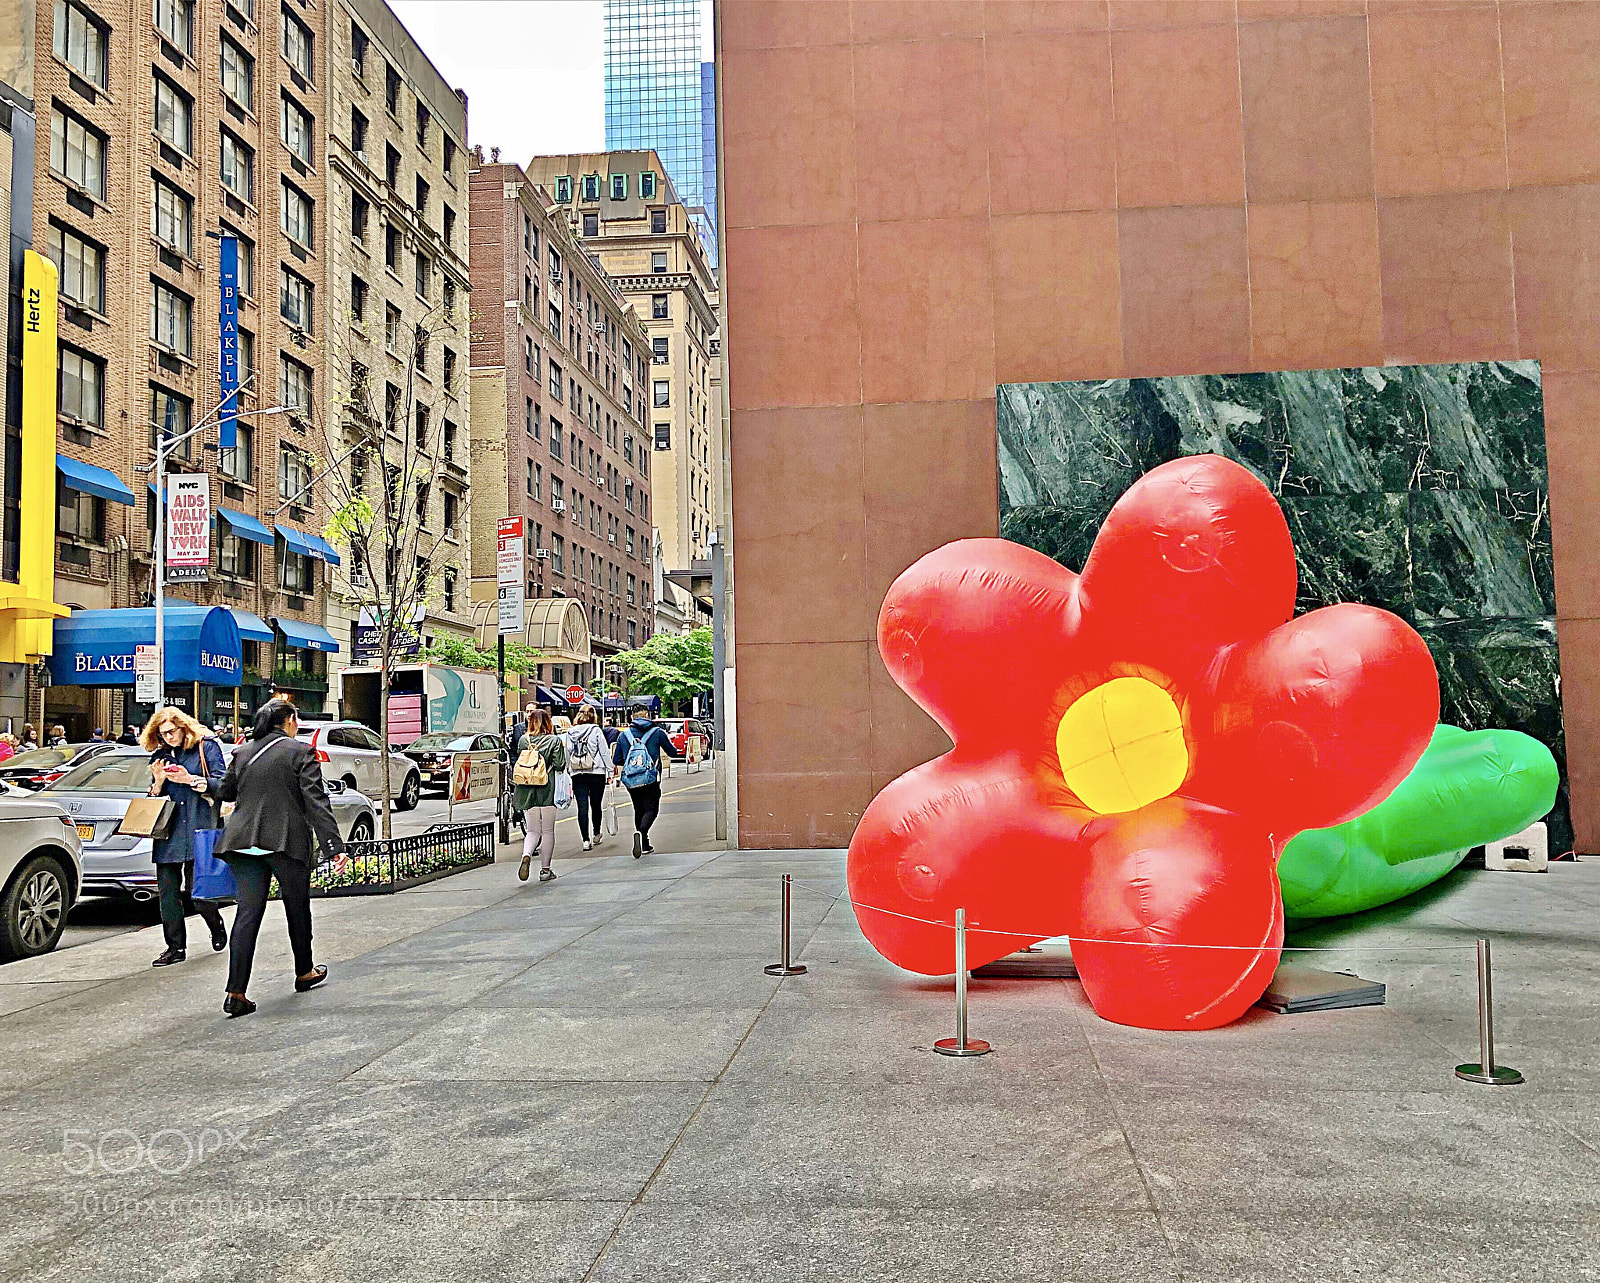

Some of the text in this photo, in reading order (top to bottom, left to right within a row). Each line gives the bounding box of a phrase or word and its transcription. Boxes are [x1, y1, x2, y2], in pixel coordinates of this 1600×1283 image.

[27, 287, 40, 333] Hertz
[223, 286, 235, 399] BLAKELY
[178, 482, 199, 490] NYC
[173, 494, 206, 508] AIDS
[170, 508, 208, 522] WALK
[173, 522, 204, 536] NEW
[499, 541, 504, 551] 3
[178, 568, 207, 577] DELTA
[499, 589, 505, 599] 6
[75, 654, 136, 671] BLAKE
[201, 652, 236, 671] BLAKELY
[566, 690, 584, 699] STOP
